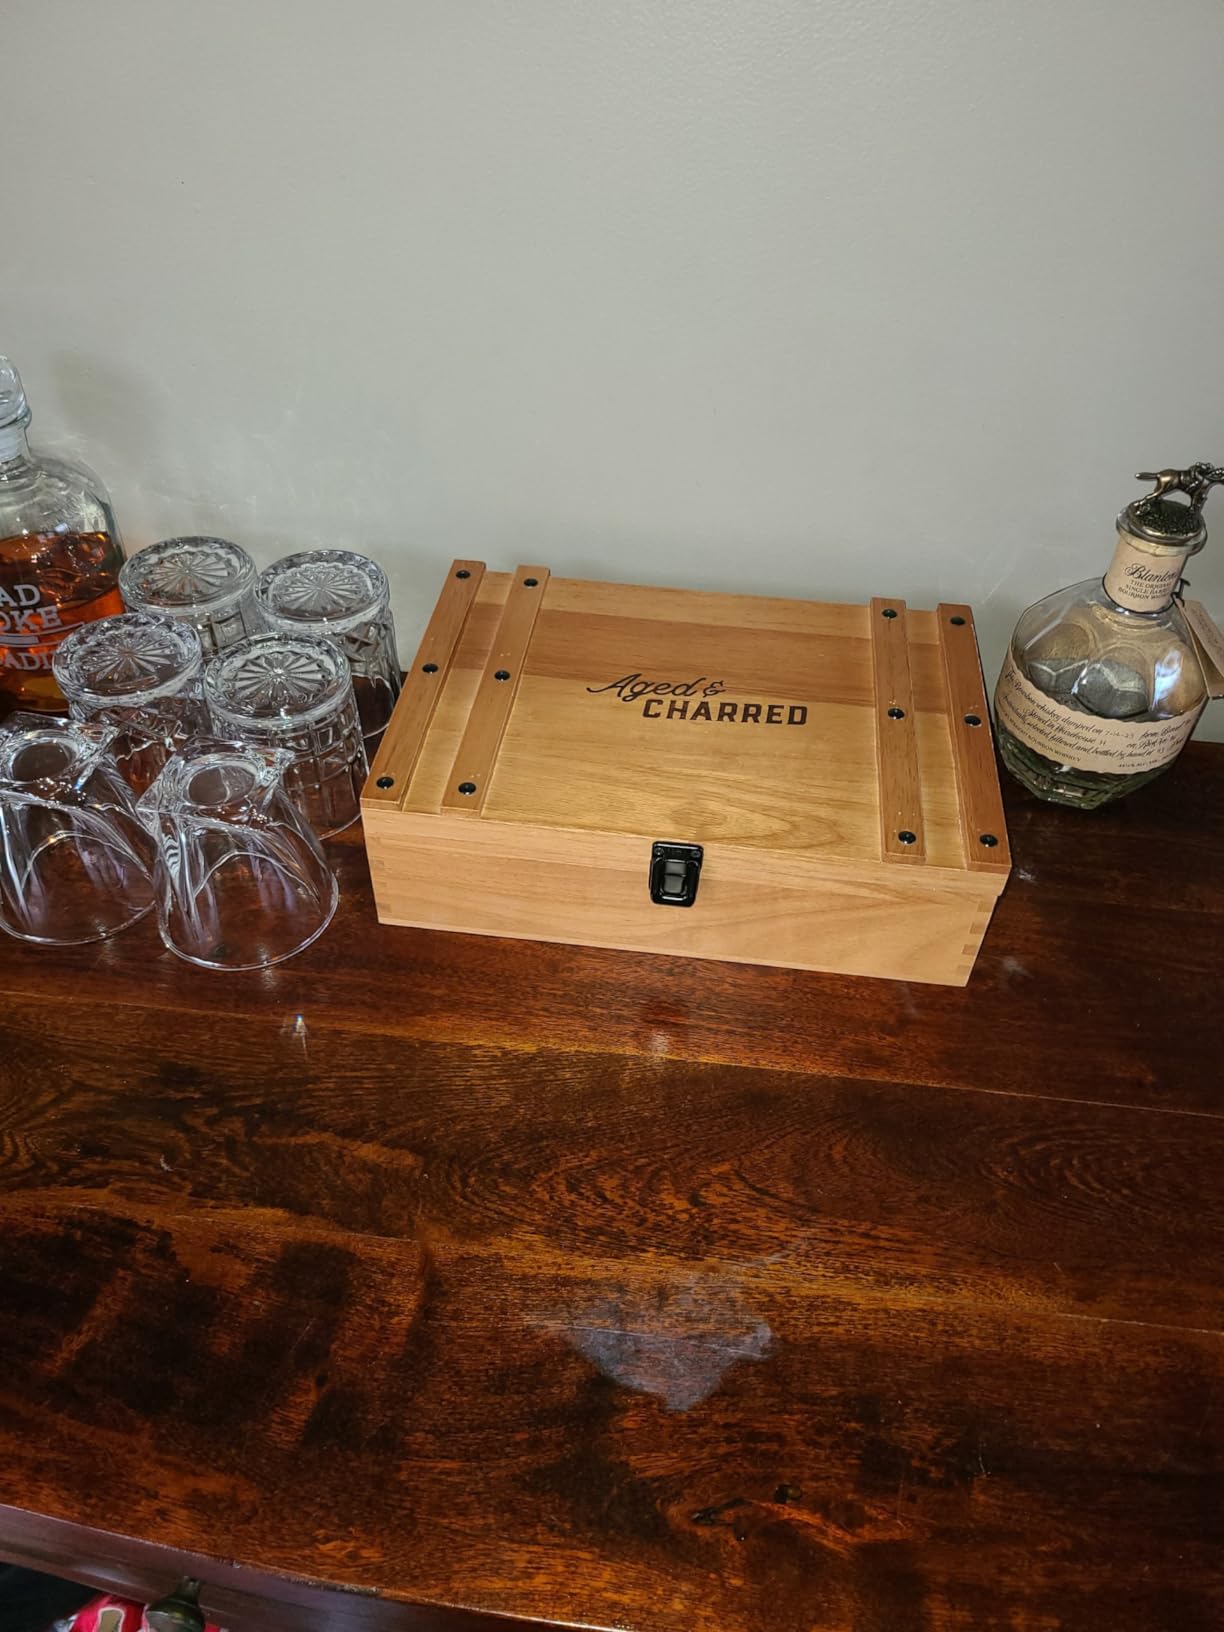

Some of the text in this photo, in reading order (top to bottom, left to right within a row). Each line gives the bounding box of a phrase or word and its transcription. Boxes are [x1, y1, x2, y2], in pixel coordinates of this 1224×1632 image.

[586, 673, 726, 702] Aged &
[642, 698, 809, 726] CHARRED
